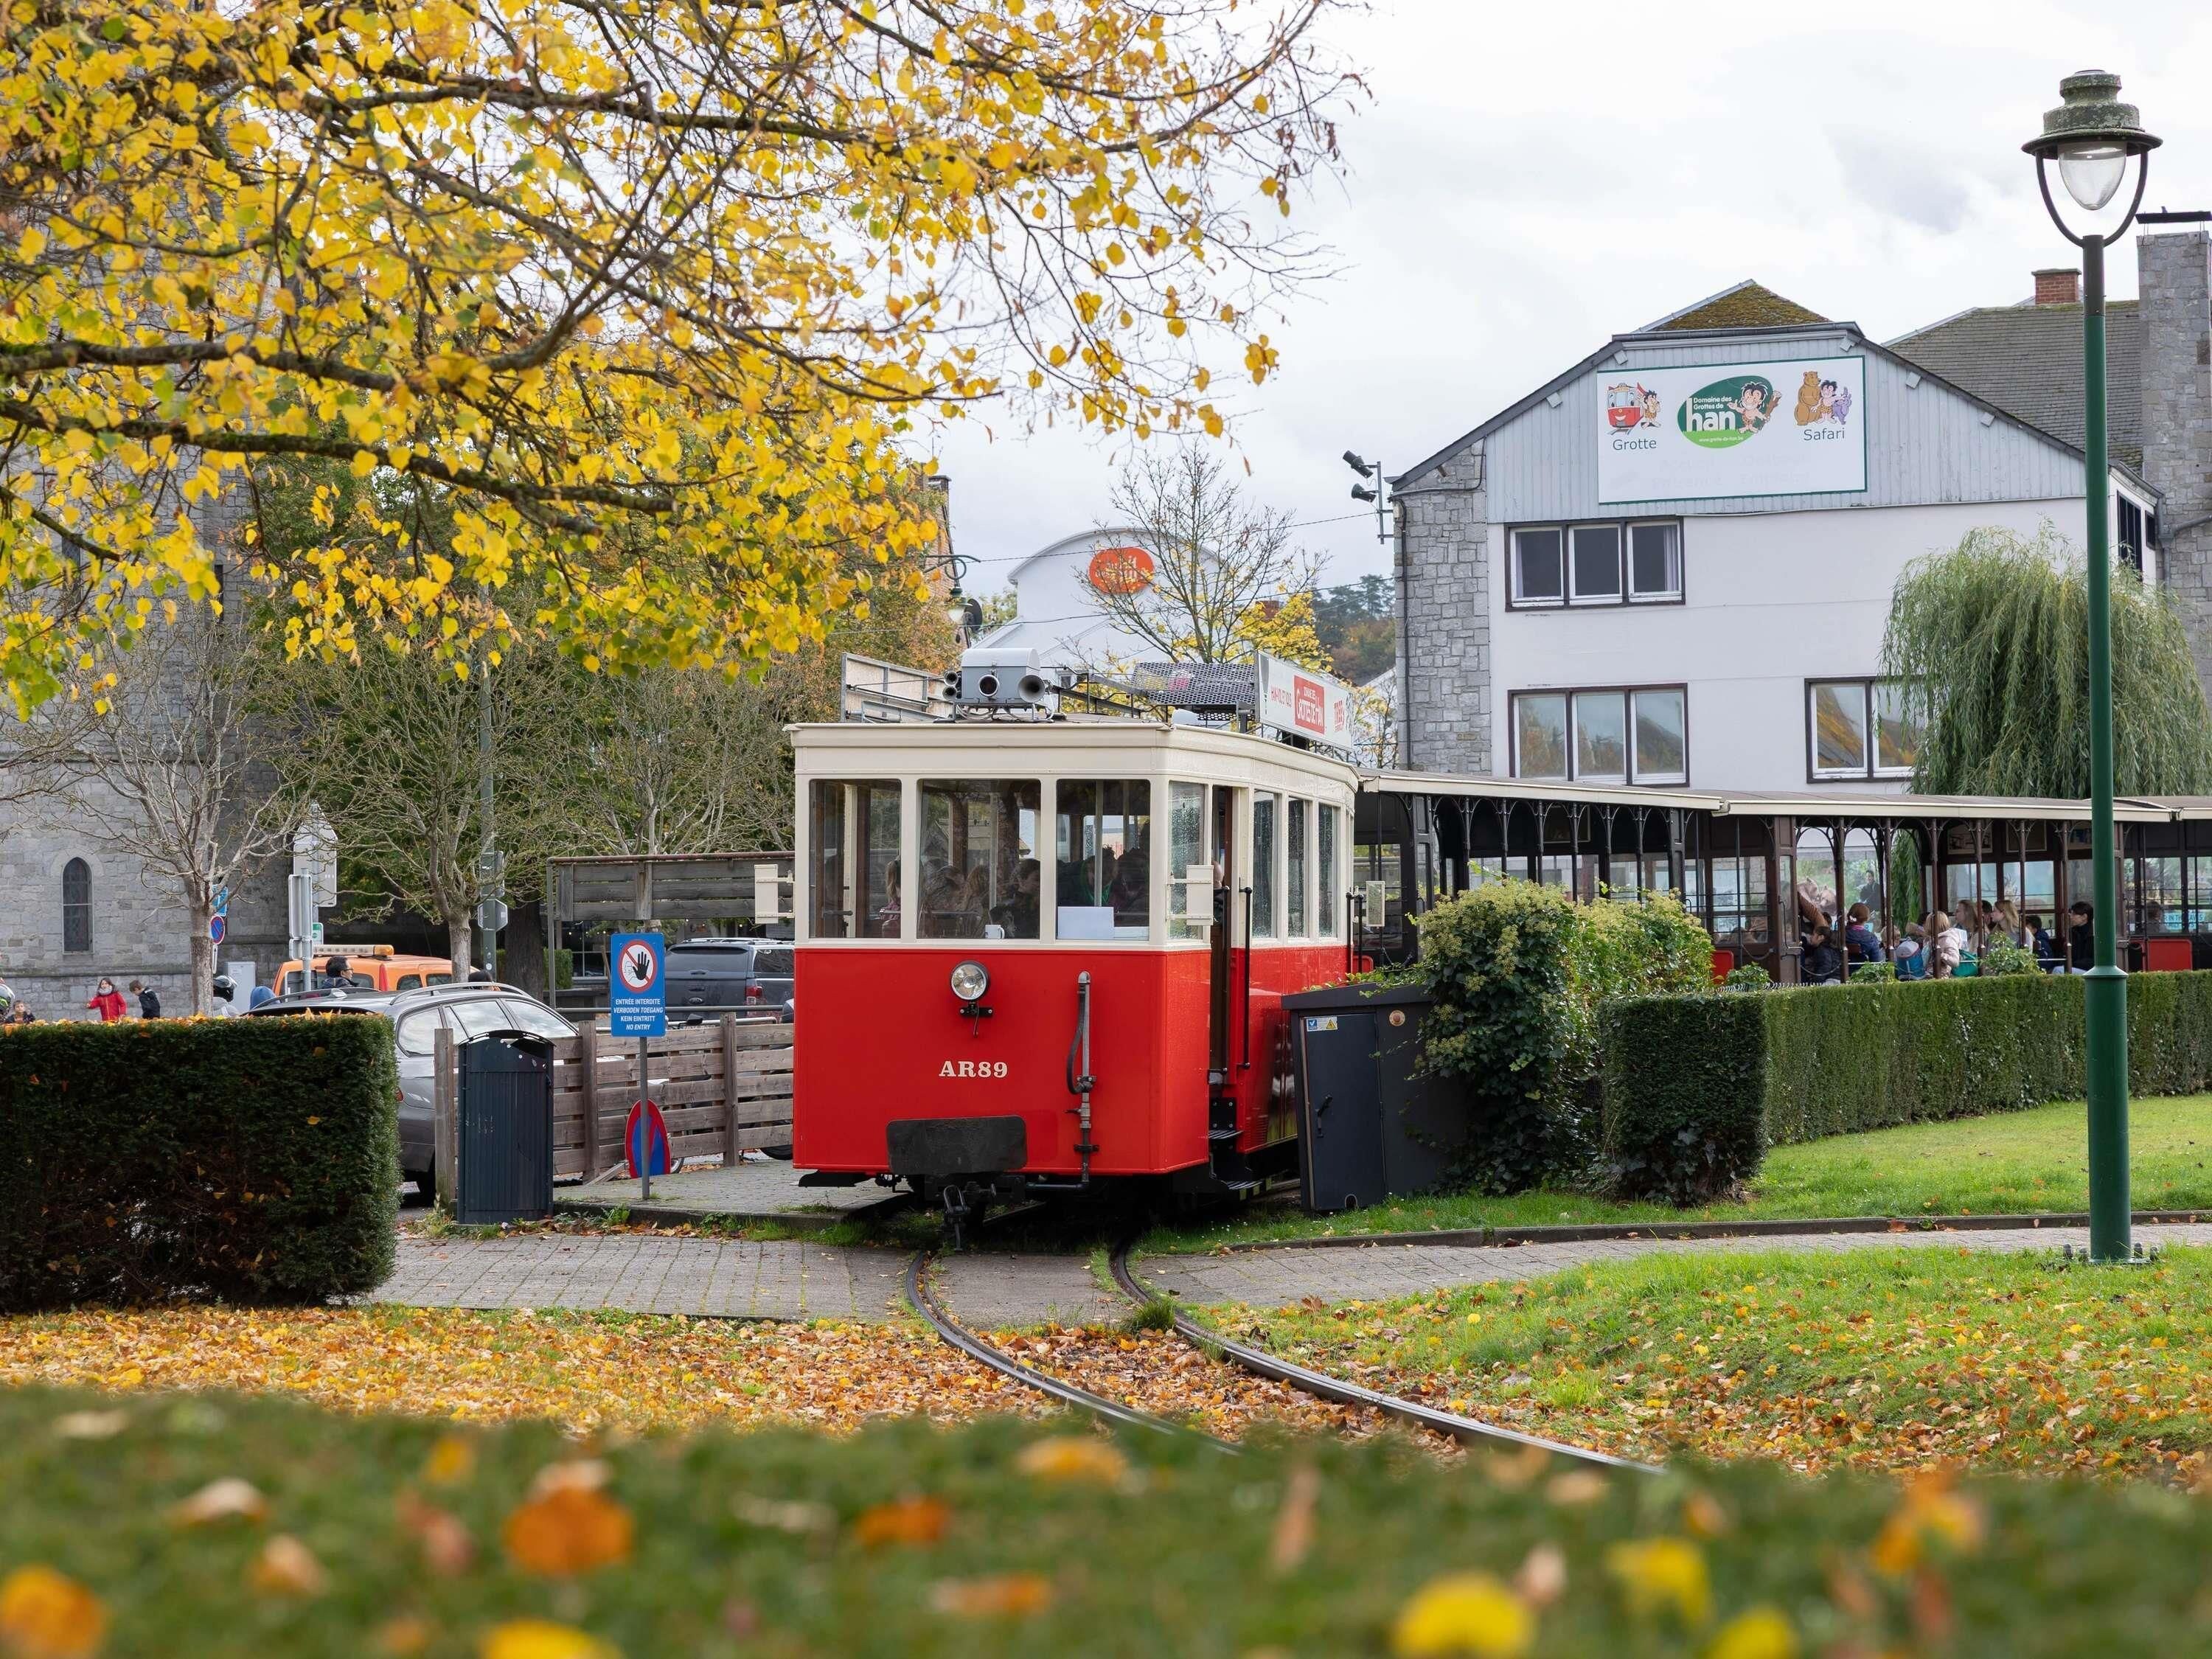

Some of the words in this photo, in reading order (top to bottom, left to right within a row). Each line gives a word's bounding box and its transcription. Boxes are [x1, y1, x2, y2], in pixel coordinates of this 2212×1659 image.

[1693, 396, 1720, 404] Domaine
[1693, 403, 1715, 411] Grottes
[1686, 397, 1736, 433] han
[1803, 427, 1846, 441] Safari
[1613, 438, 1657, 451] Grotte
[939, 1060, 1009, 1078] AR89
